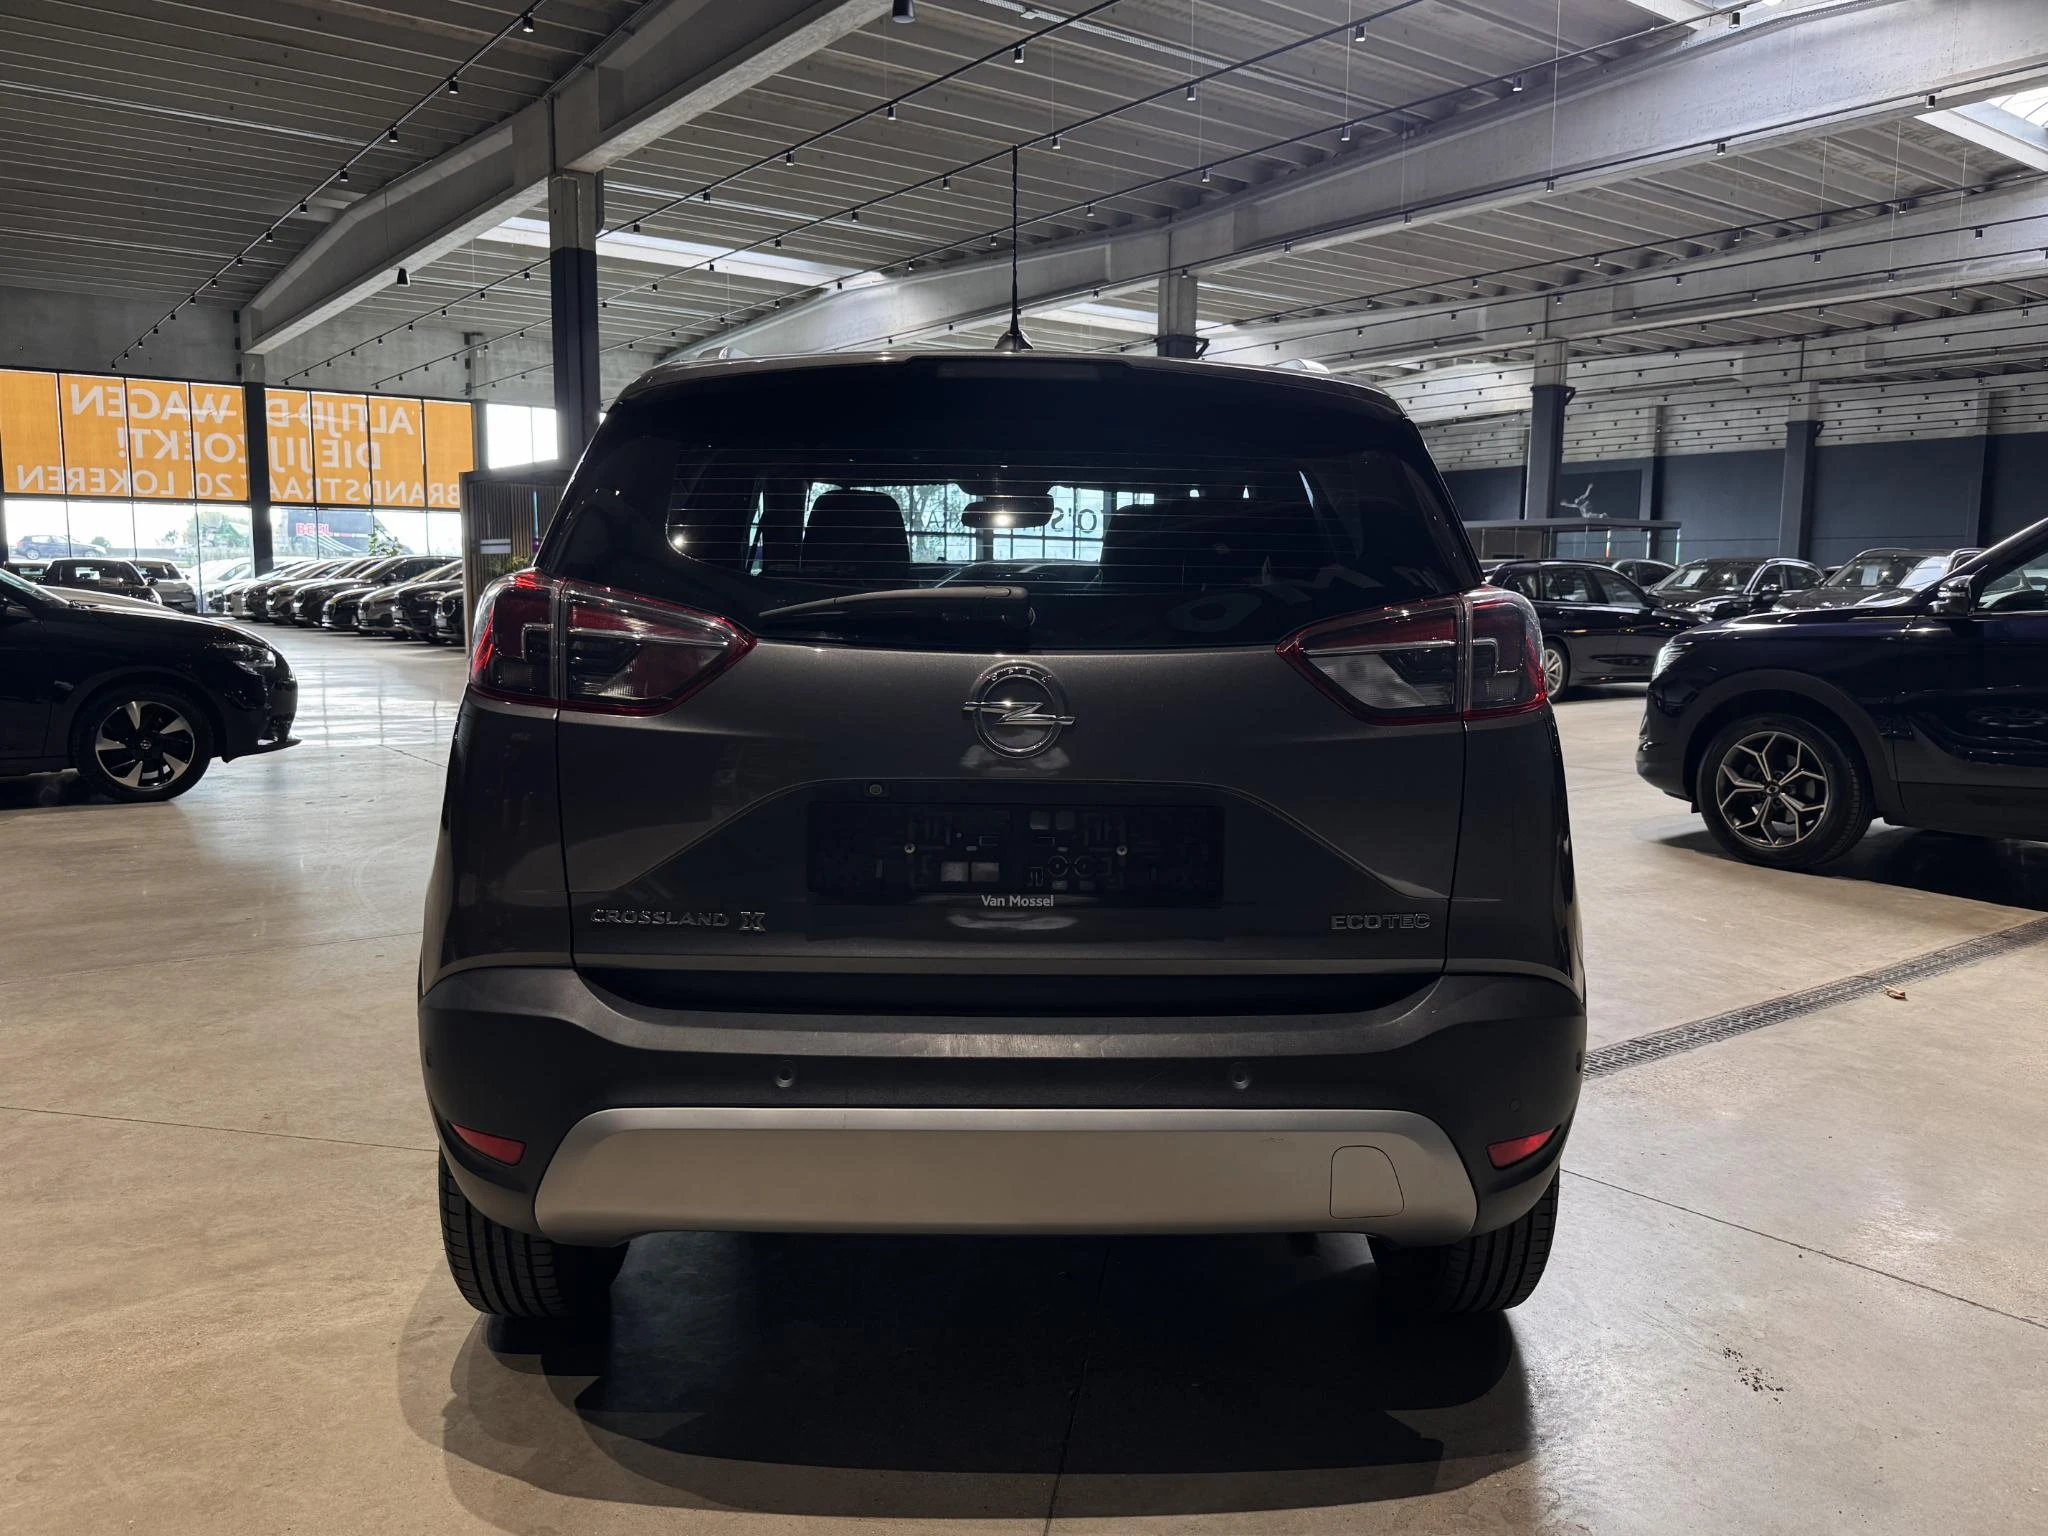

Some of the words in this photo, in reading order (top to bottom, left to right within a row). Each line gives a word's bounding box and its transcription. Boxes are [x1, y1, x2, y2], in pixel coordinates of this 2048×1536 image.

[991, 669, 1048, 683] OPEL
[981, 895, 1005, 907] Van
[1009, 894, 1054, 907] Mossel
[591, 908, 729, 927] CROSSLAND
[739, 911, 767, 932] X
[1330, 913, 1431, 930] ECOTEC
